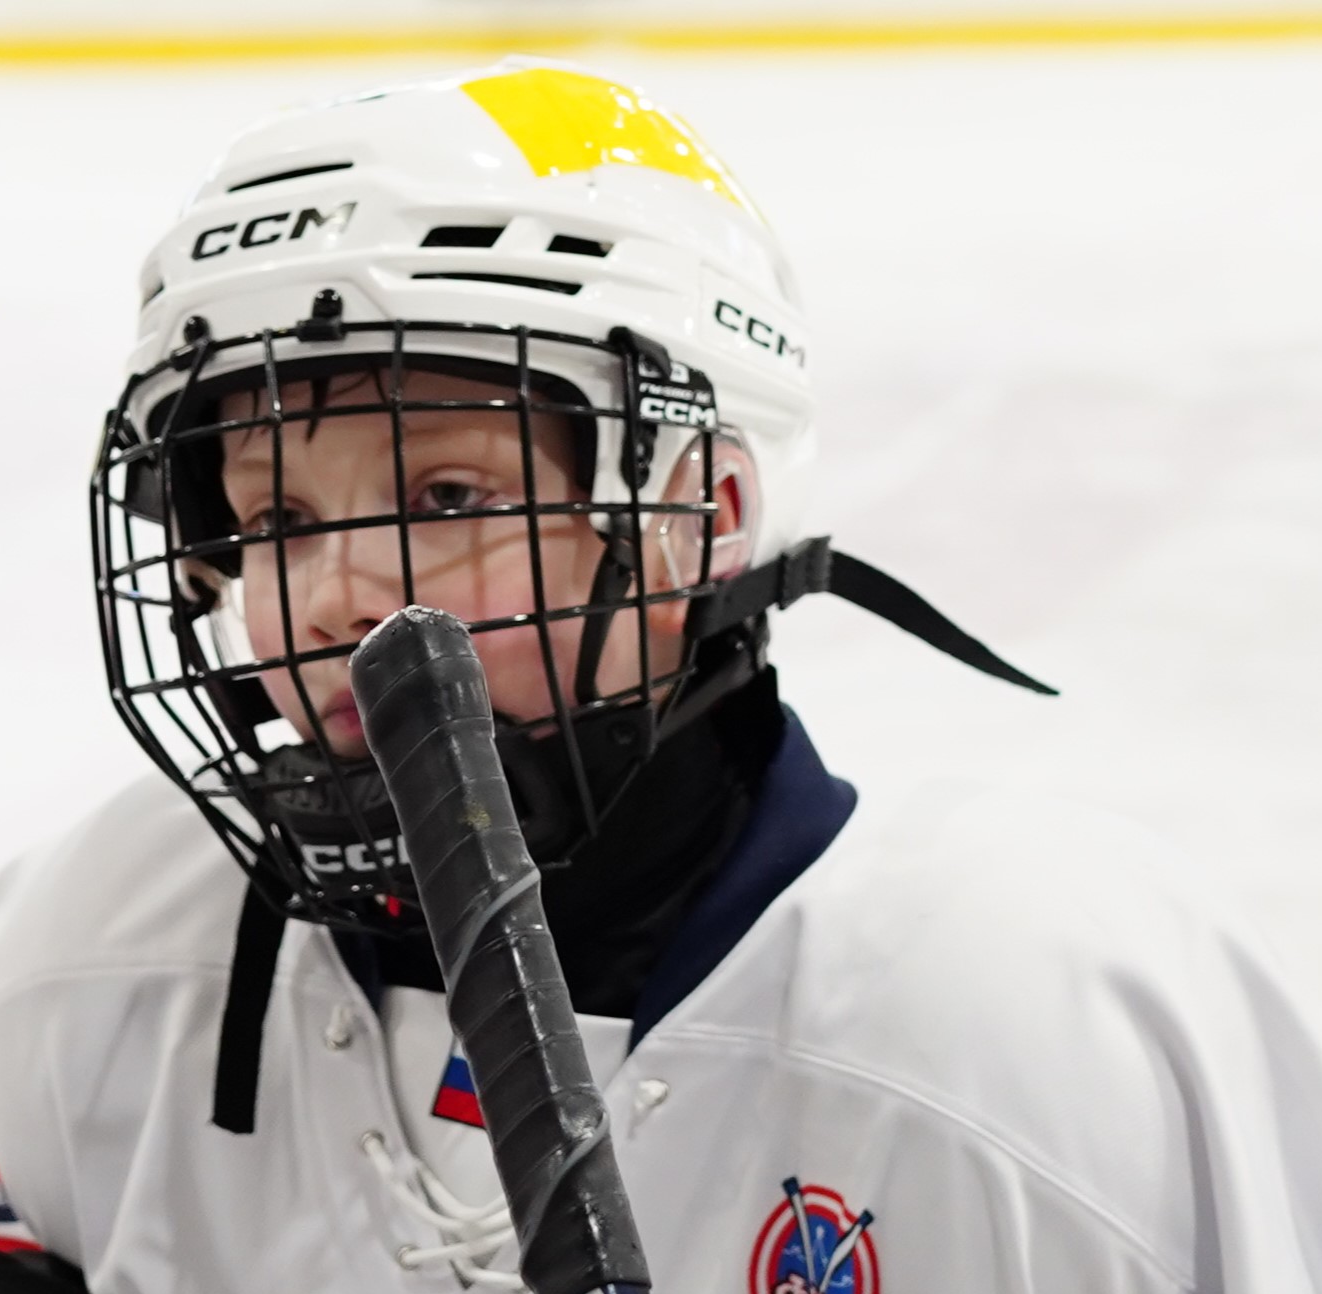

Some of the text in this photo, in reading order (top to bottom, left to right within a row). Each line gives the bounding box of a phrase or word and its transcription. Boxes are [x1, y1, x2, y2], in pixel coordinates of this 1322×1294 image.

[190, 201, 359, 261] CCM
[714, 299, 806, 370] CCM
[639, 397, 718, 429] CCM
